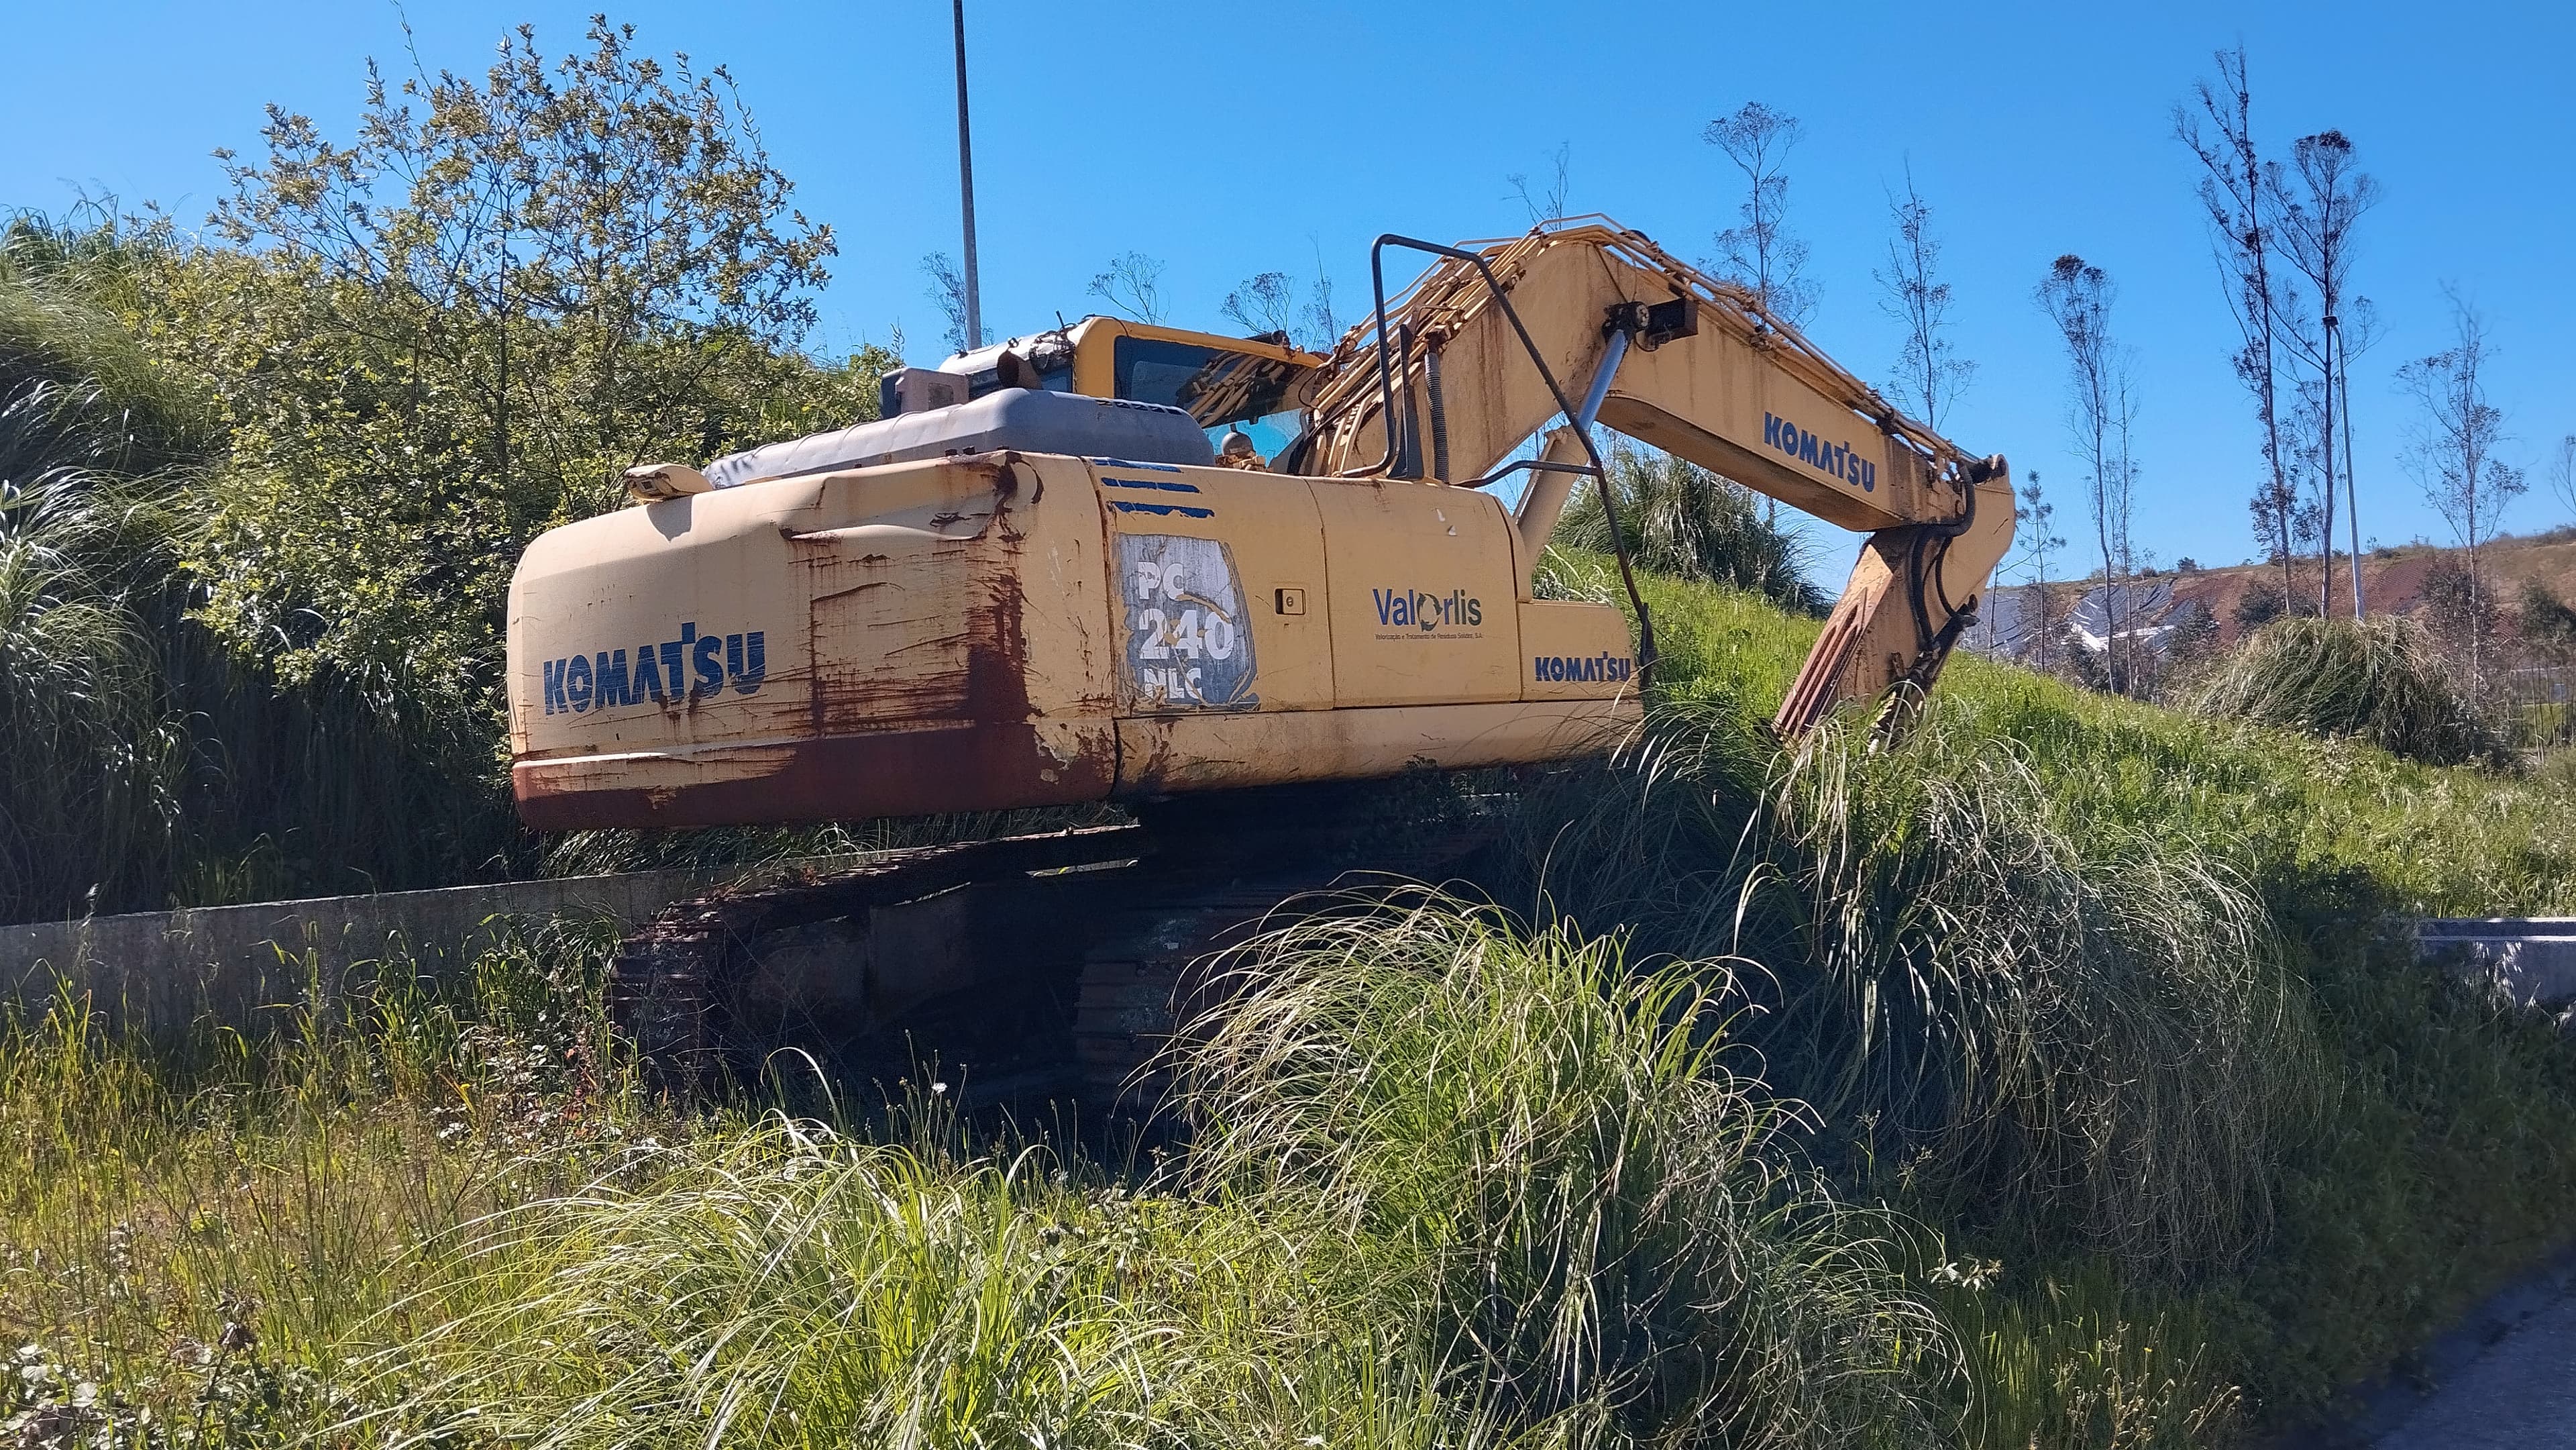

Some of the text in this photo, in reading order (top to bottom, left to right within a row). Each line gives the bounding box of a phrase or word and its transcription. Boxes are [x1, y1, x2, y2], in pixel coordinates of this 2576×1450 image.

[1764, 411, 1876, 493] KOMATSU
[1138, 562, 1185, 601] PC
[1139, 609, 1234, 660] 240
[543, 621, 767, 716] KOMATSU
[1144, 668, 1203, 698] NLC
[1535, 651, 1630, 682] KOMATSU
